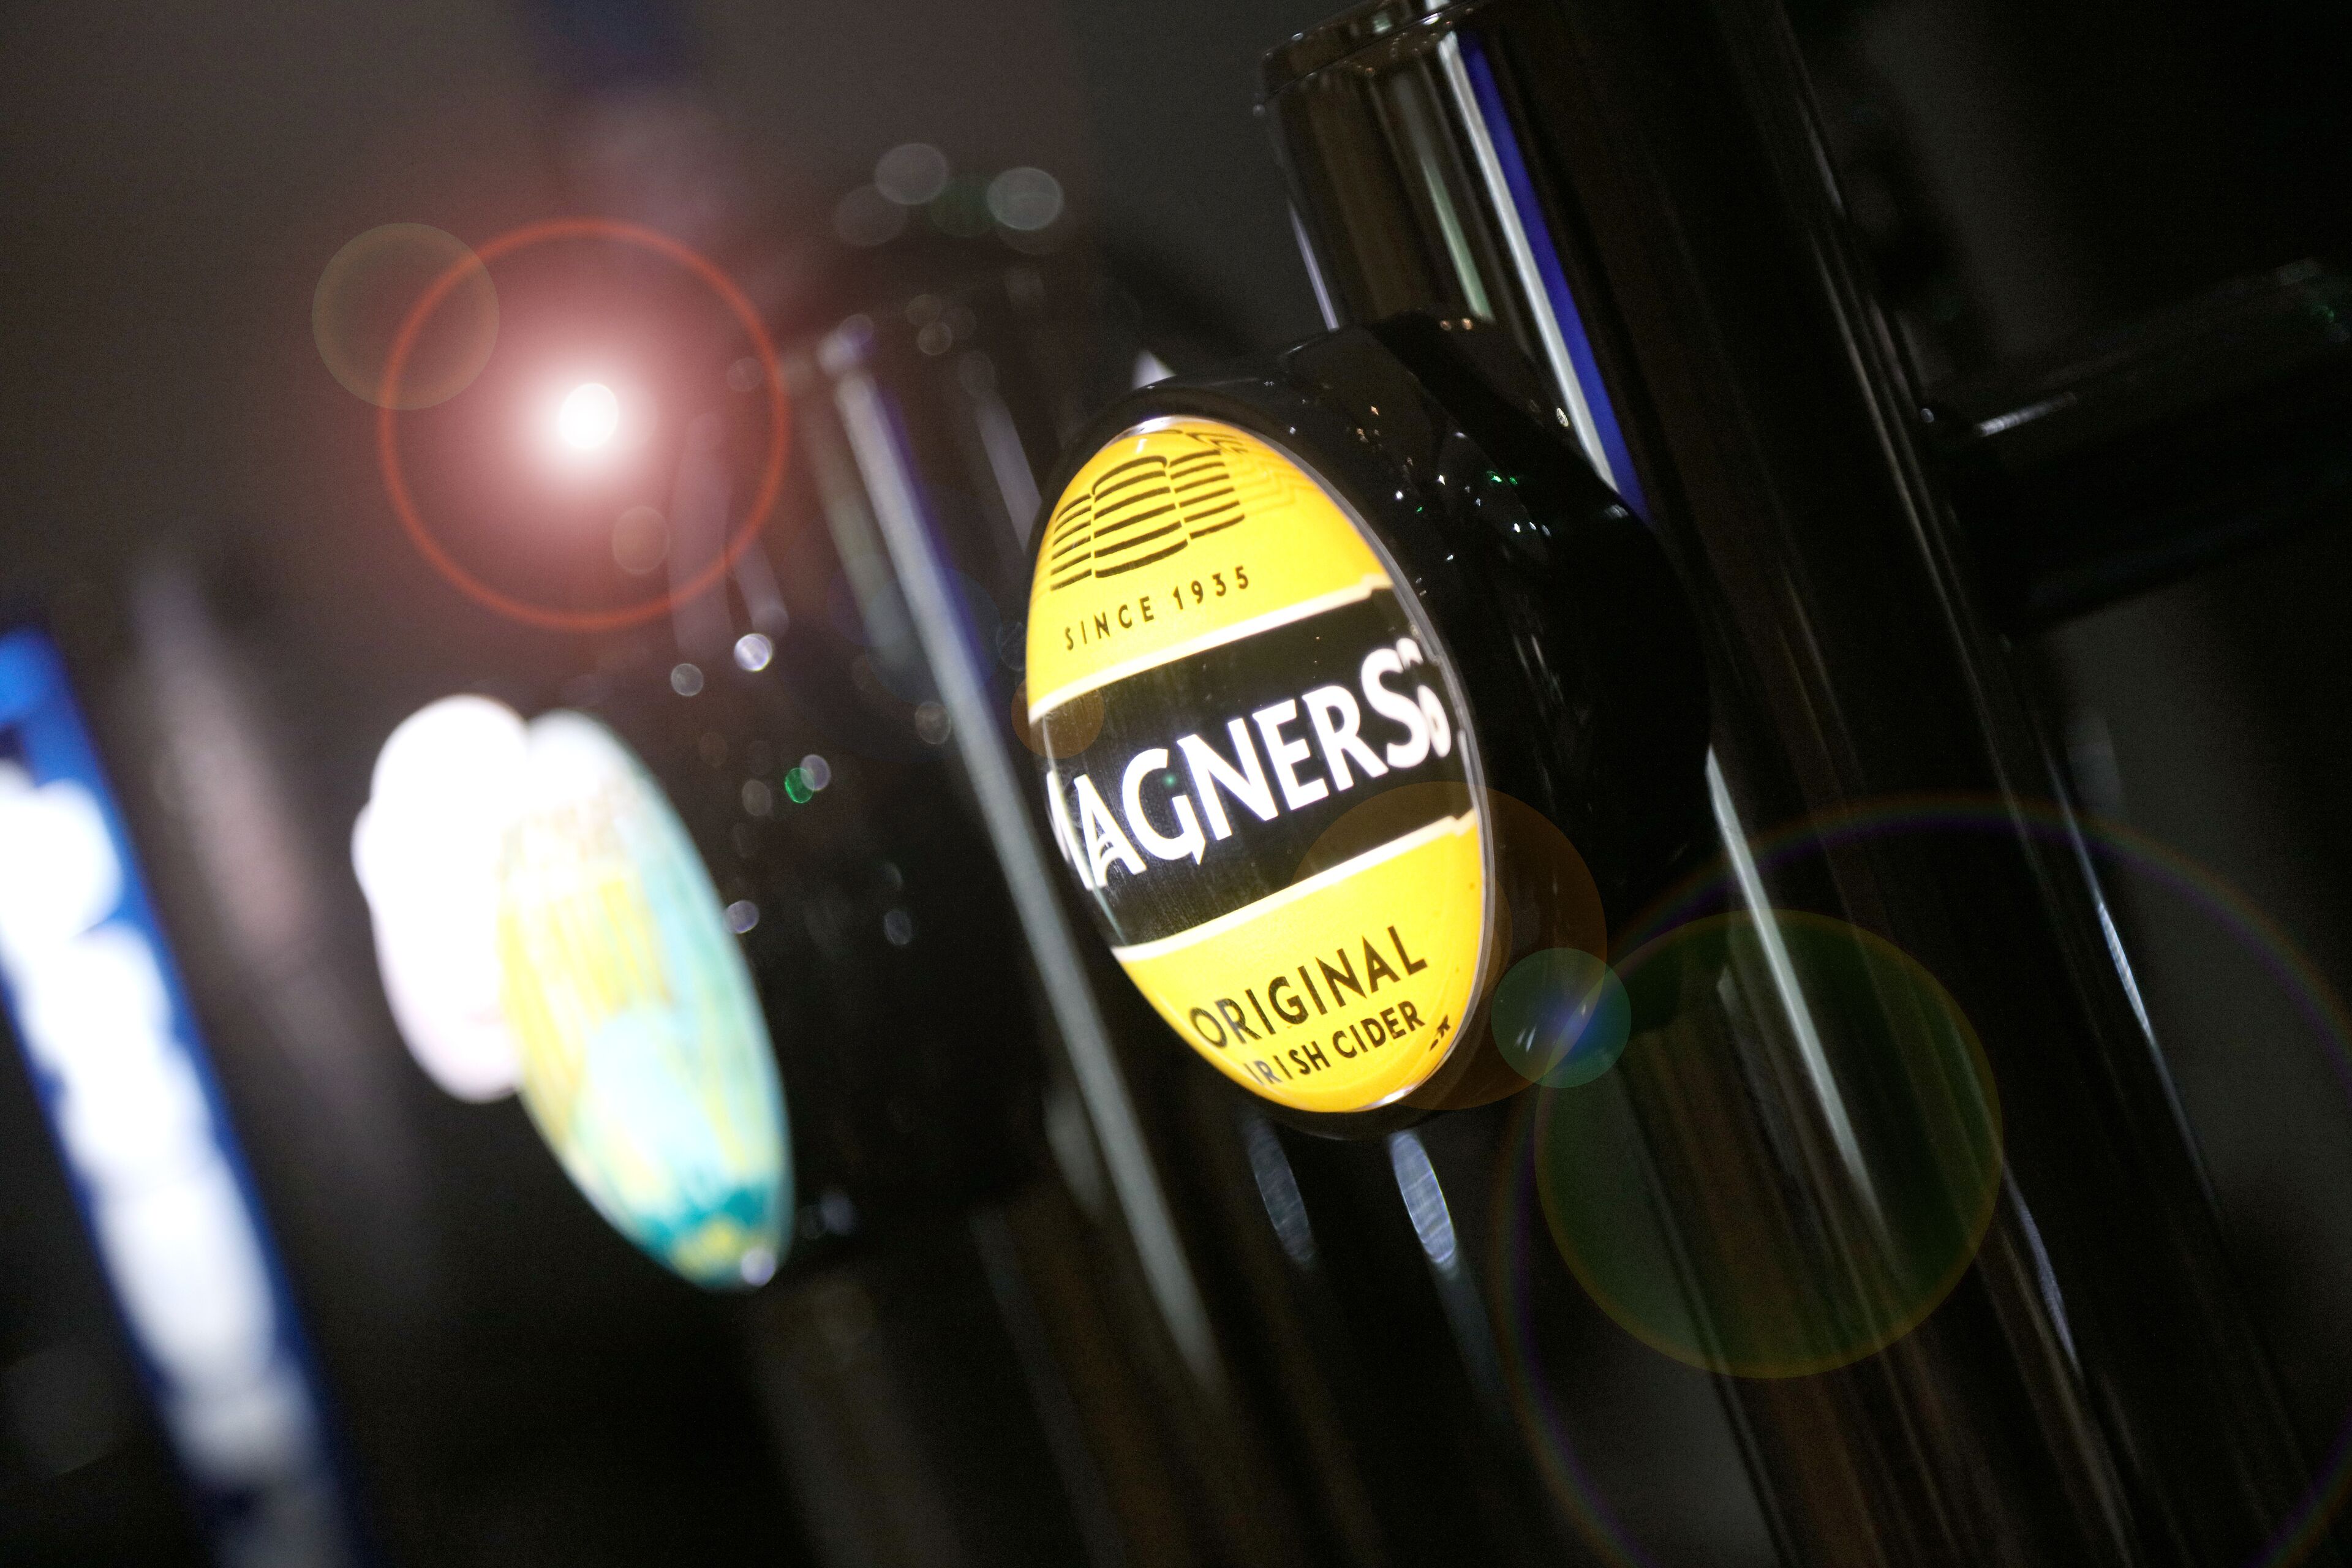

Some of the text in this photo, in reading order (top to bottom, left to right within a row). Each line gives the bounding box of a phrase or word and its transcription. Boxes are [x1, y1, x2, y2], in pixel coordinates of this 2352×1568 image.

[1065, 565, 1249, 651] SINCE 1935
[1188, 925, 1428, 1049] ORIGINAL
[1242, 1000, 1426, 1086] IRISH CIDER
